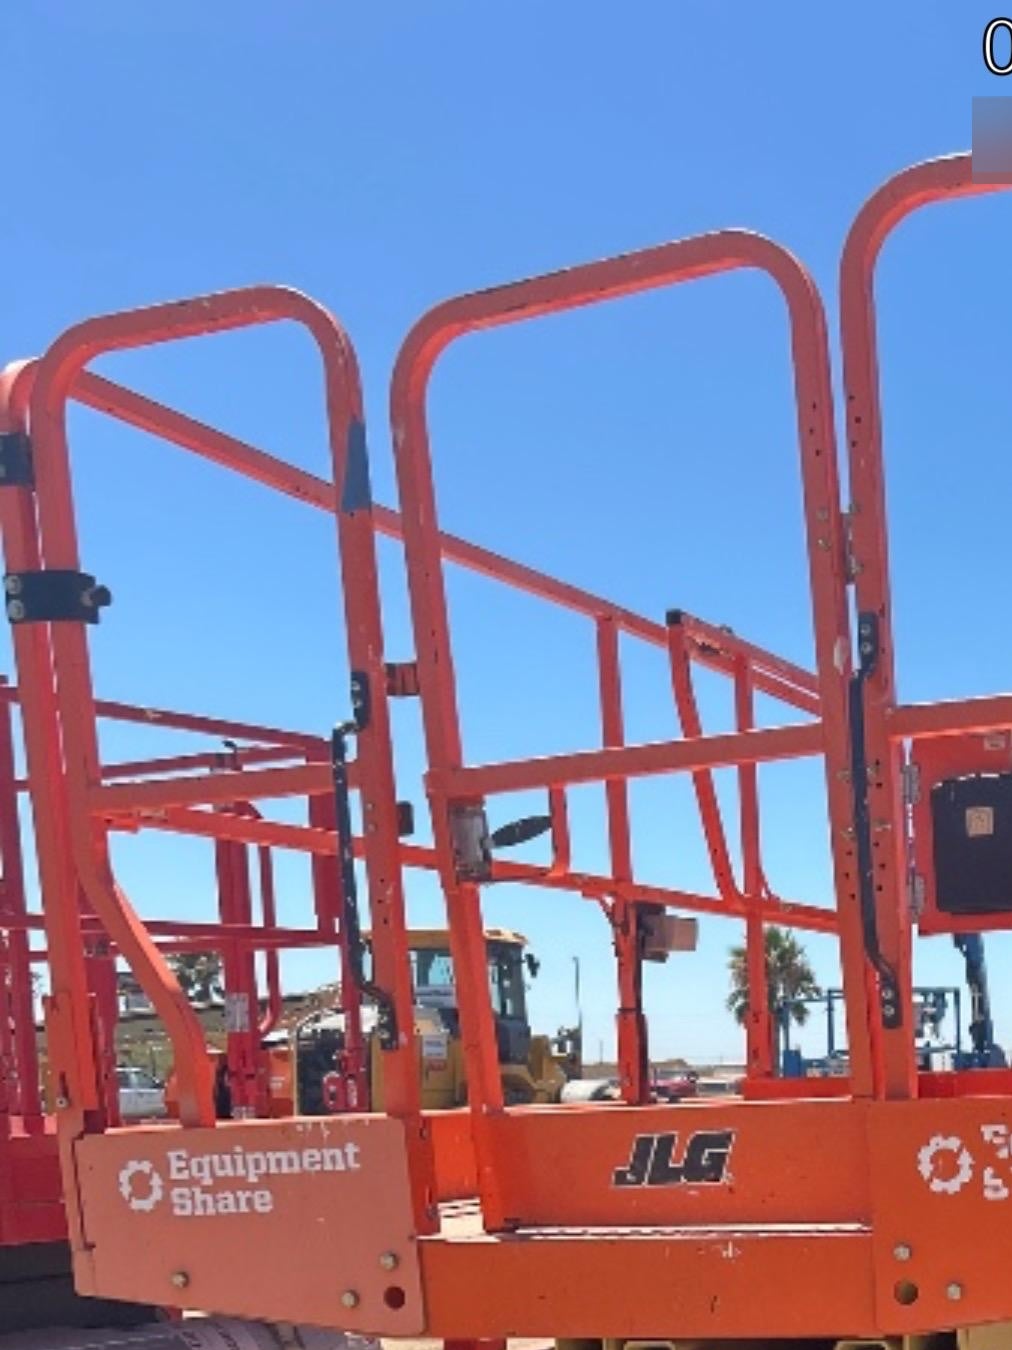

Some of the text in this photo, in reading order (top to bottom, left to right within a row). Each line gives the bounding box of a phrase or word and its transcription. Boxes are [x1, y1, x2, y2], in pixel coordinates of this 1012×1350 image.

[167, 1142, 361, 1186] Equipment
[611, 1129, 735, 1188] JLG
[170, 1187, 273, 1216] Share
